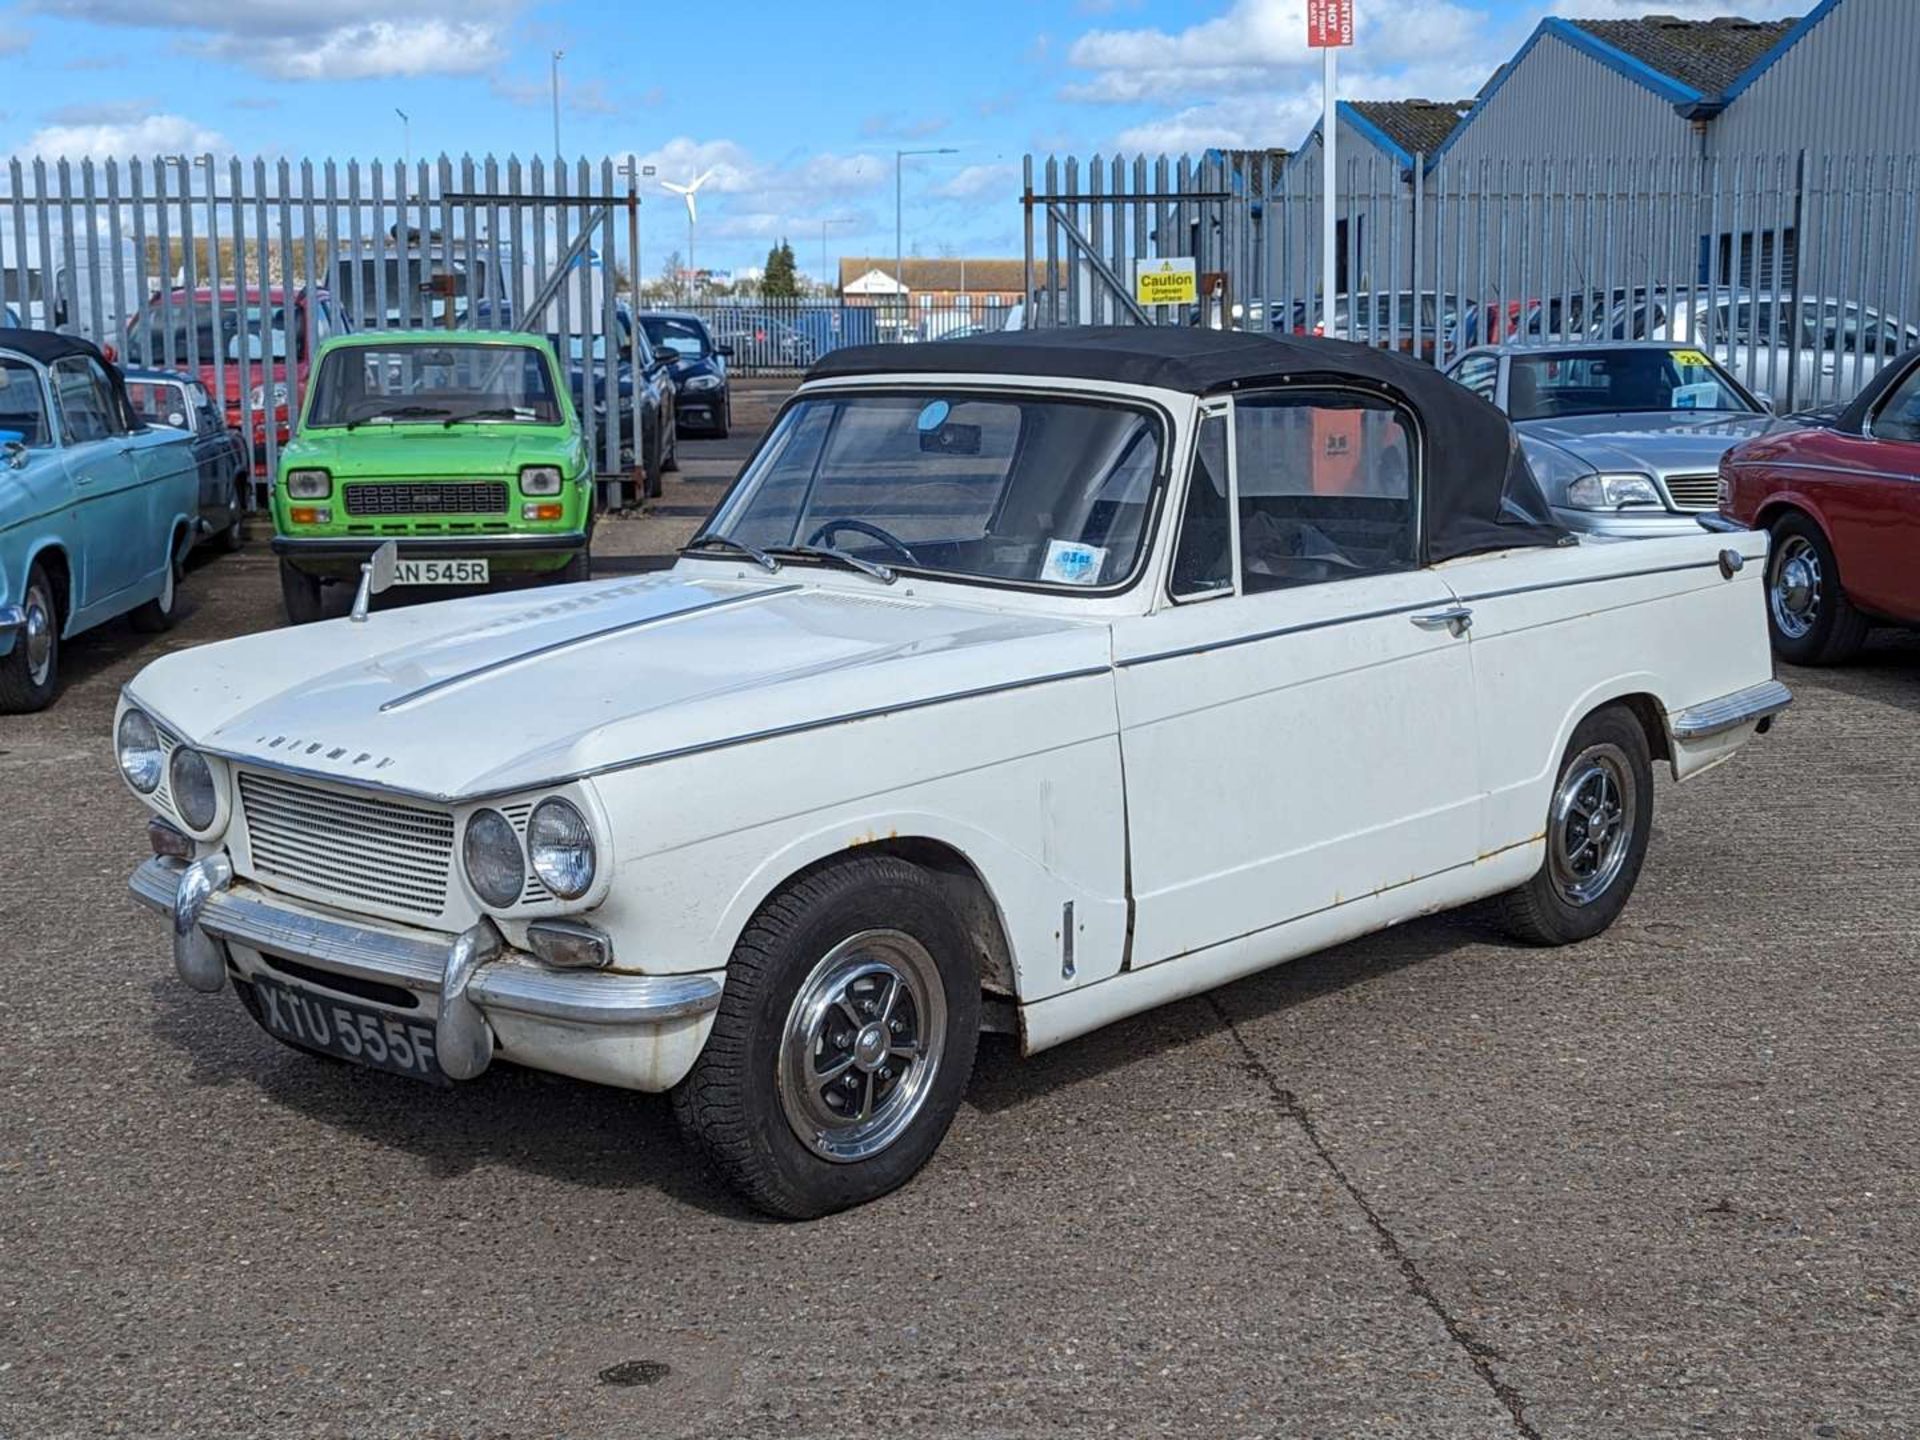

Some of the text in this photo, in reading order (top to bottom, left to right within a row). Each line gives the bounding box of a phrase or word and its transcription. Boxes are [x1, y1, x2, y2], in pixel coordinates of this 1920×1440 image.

[1310, 2, 1318, 26] GATE
[1328, 3, 1337, 31] NOT
[1141, 274, 1193, 287] Caution
[426, 563, 486, 582] 545R
[257, 983, 435, 1073] XTU 555F
